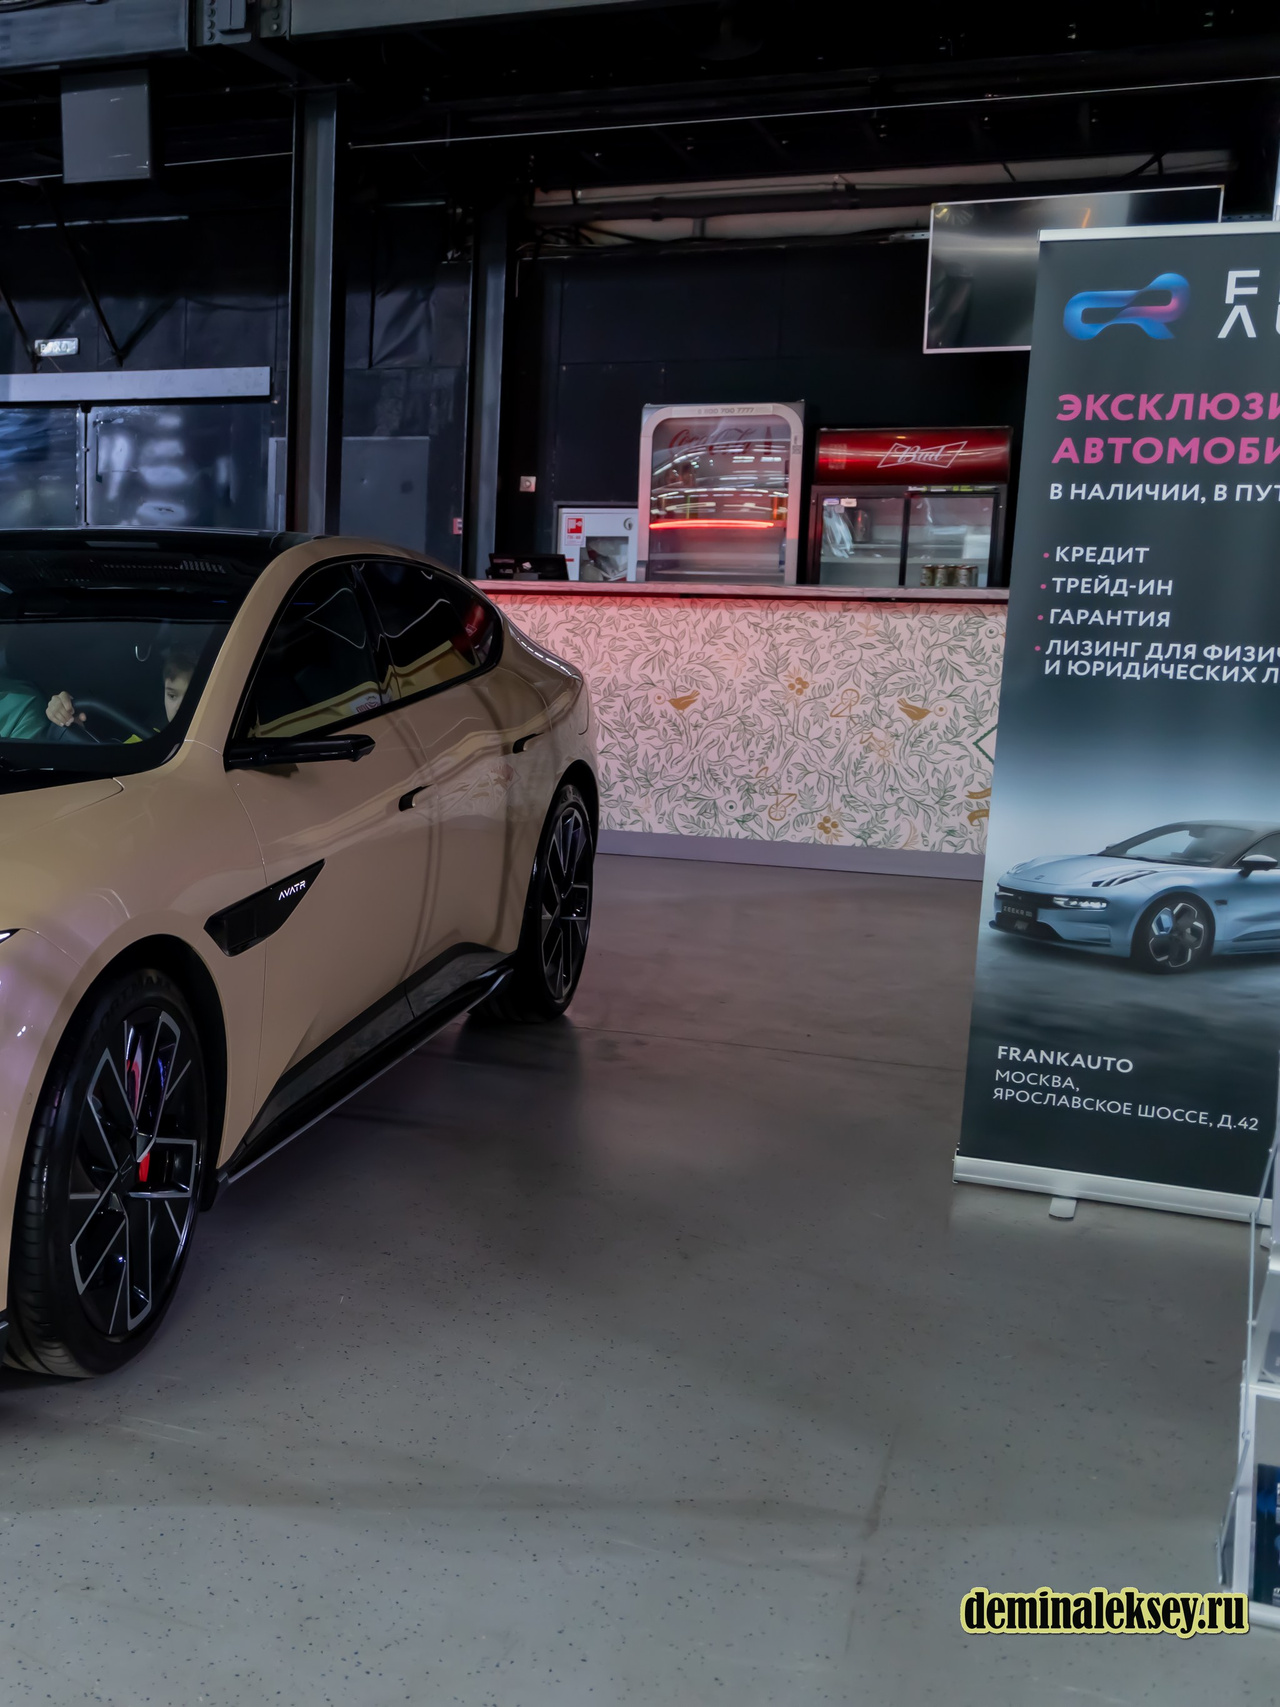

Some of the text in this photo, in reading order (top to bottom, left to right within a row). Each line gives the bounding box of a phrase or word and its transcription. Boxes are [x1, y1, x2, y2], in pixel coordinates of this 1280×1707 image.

[894, 445, 947, 463] Bud
[1049, 483, 1063, 500] В
[1070, 483, 1207, 504] НАЛИЧИИ,
[1213, 484, 1228, 501] В
[1055, 546, 1150, 565] КРЕДИТ
[1052, 575, 1173, 597] ТРЕЙД-ИН
[1049, 608, 1171, 628] ГАРАНТИЯ
[1045, 639, 1280, 664] ЛИЗИНГ ДЛЯ ФИЗИ
[1044, 660, 1061, 676] И
[1067, 660, 1257, 683] ЮРИДИЧЕСКИХ
[278, 880, 306, 901] AVATR
[997, 1045, 1133, 1073] FRANKAUTO
[995, 1069, 1080, 1092] МОСКВА,
[992, 1088, 1259, 1131] ЯРОСЛАВСКОЕ ШОССЕ, Д.42
